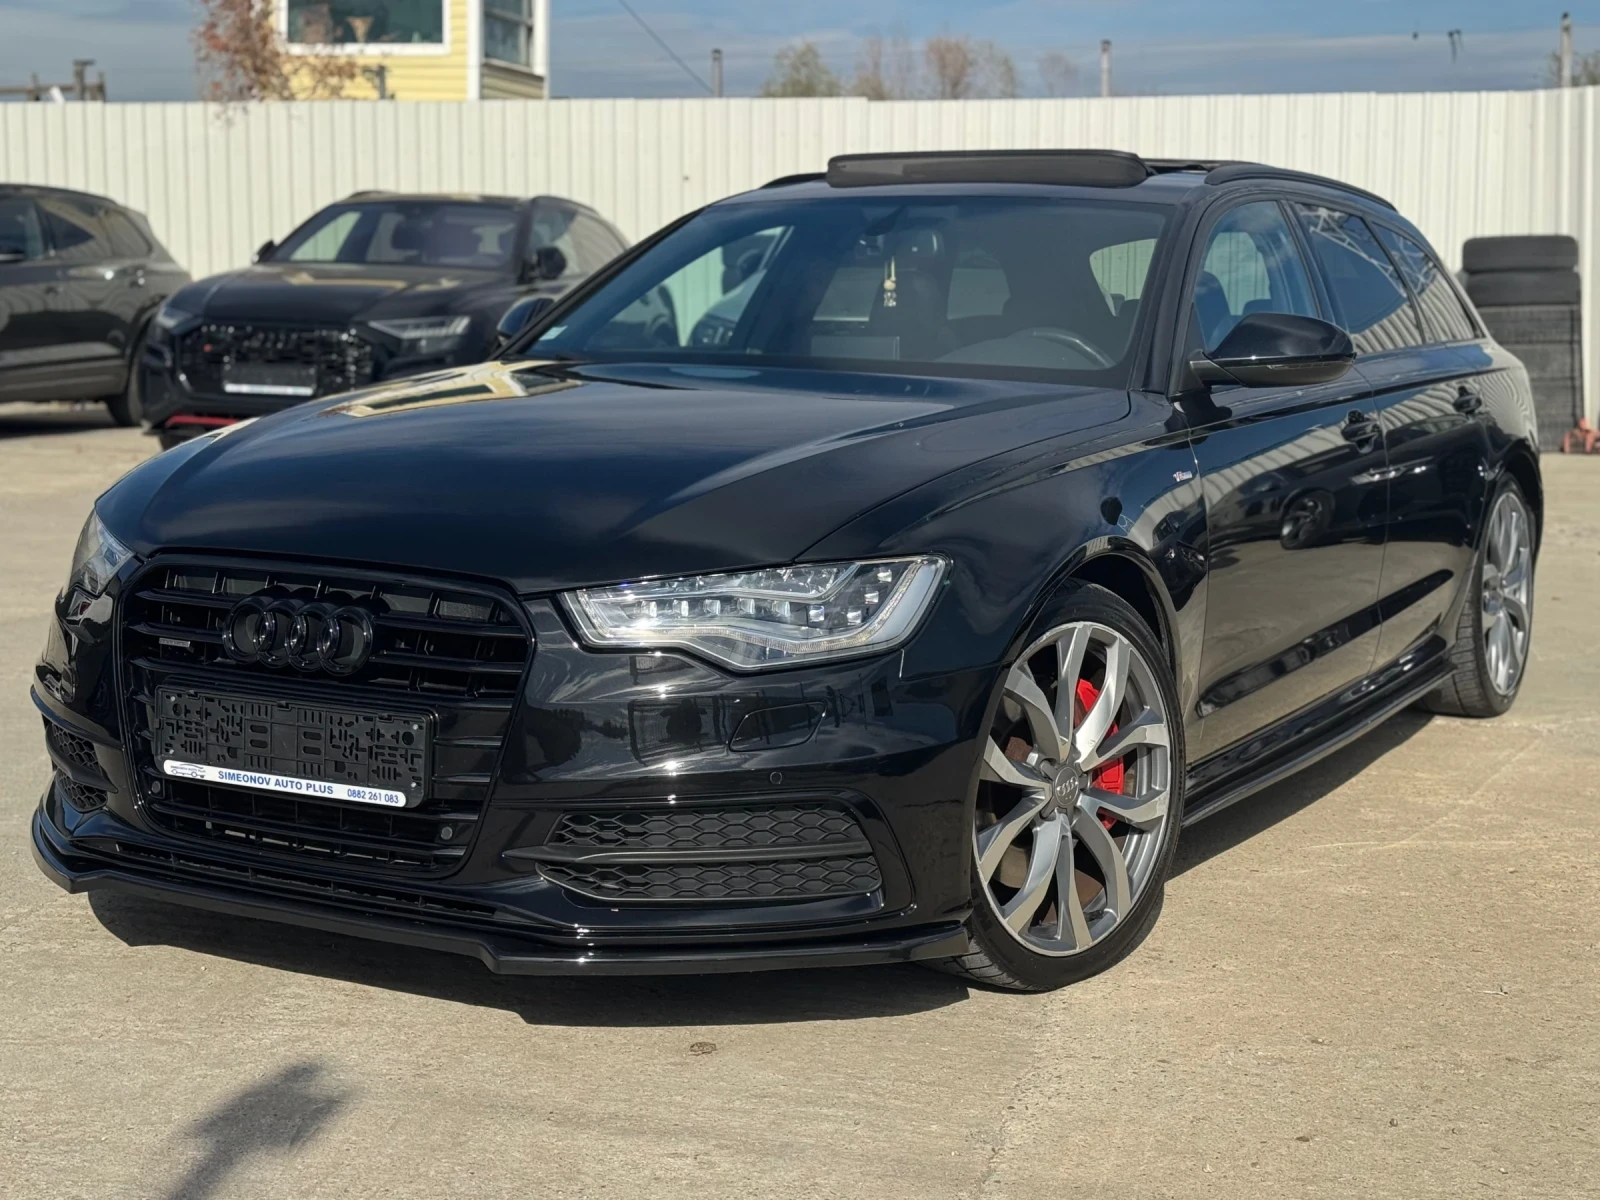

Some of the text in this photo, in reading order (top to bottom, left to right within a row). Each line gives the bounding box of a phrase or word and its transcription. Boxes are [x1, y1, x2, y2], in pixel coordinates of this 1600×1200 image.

[218, 771, 398, 803] SIMEONOV AUTO PLUS 0882 261 083
